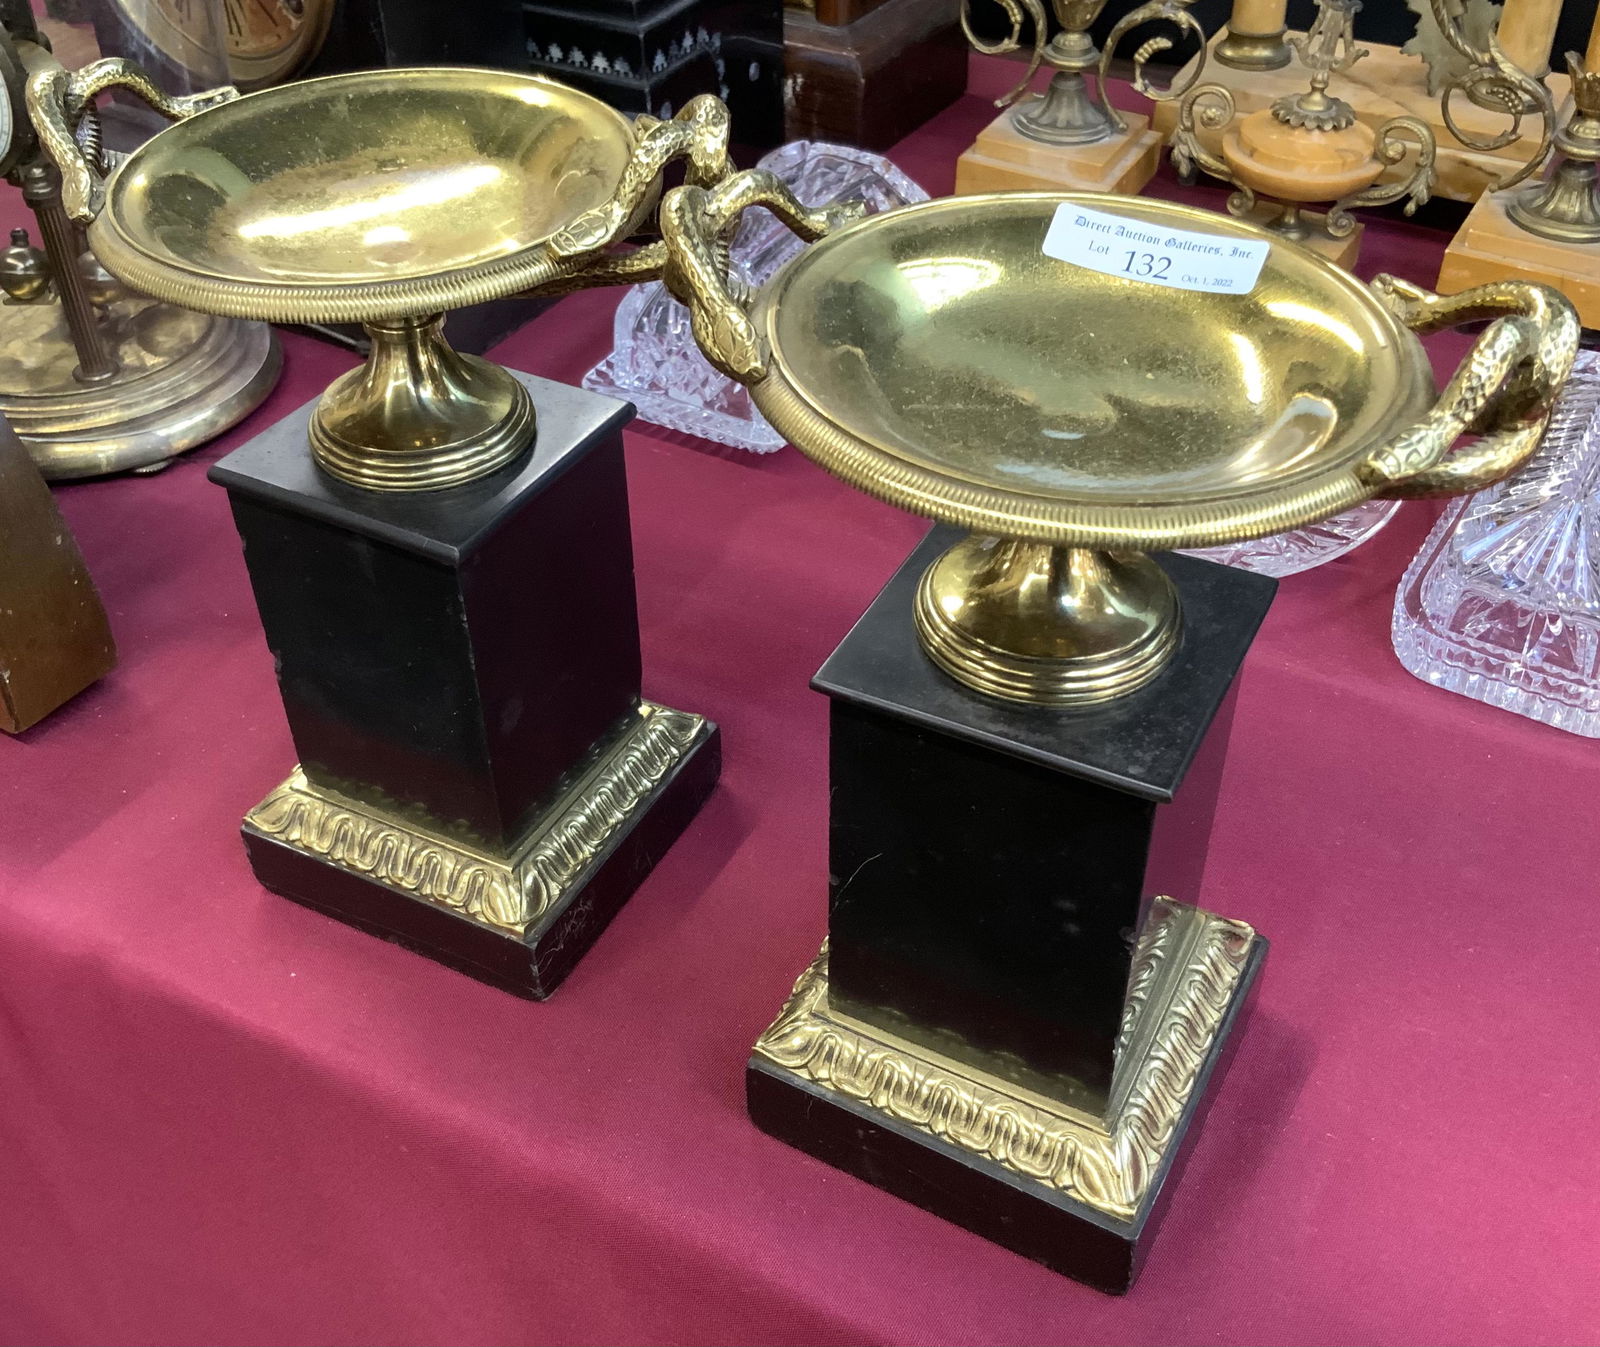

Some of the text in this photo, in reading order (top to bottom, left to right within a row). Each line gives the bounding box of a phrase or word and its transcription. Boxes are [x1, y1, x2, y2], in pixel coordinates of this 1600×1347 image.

[1074, 215, 1254, 260] Direct Auction Galleries, Inc.
[1088, 240, 1173, 281] Lot 132
[1181, 274, 1200, 285] Oct.
[1211, 278, 1233, 288] 2022
